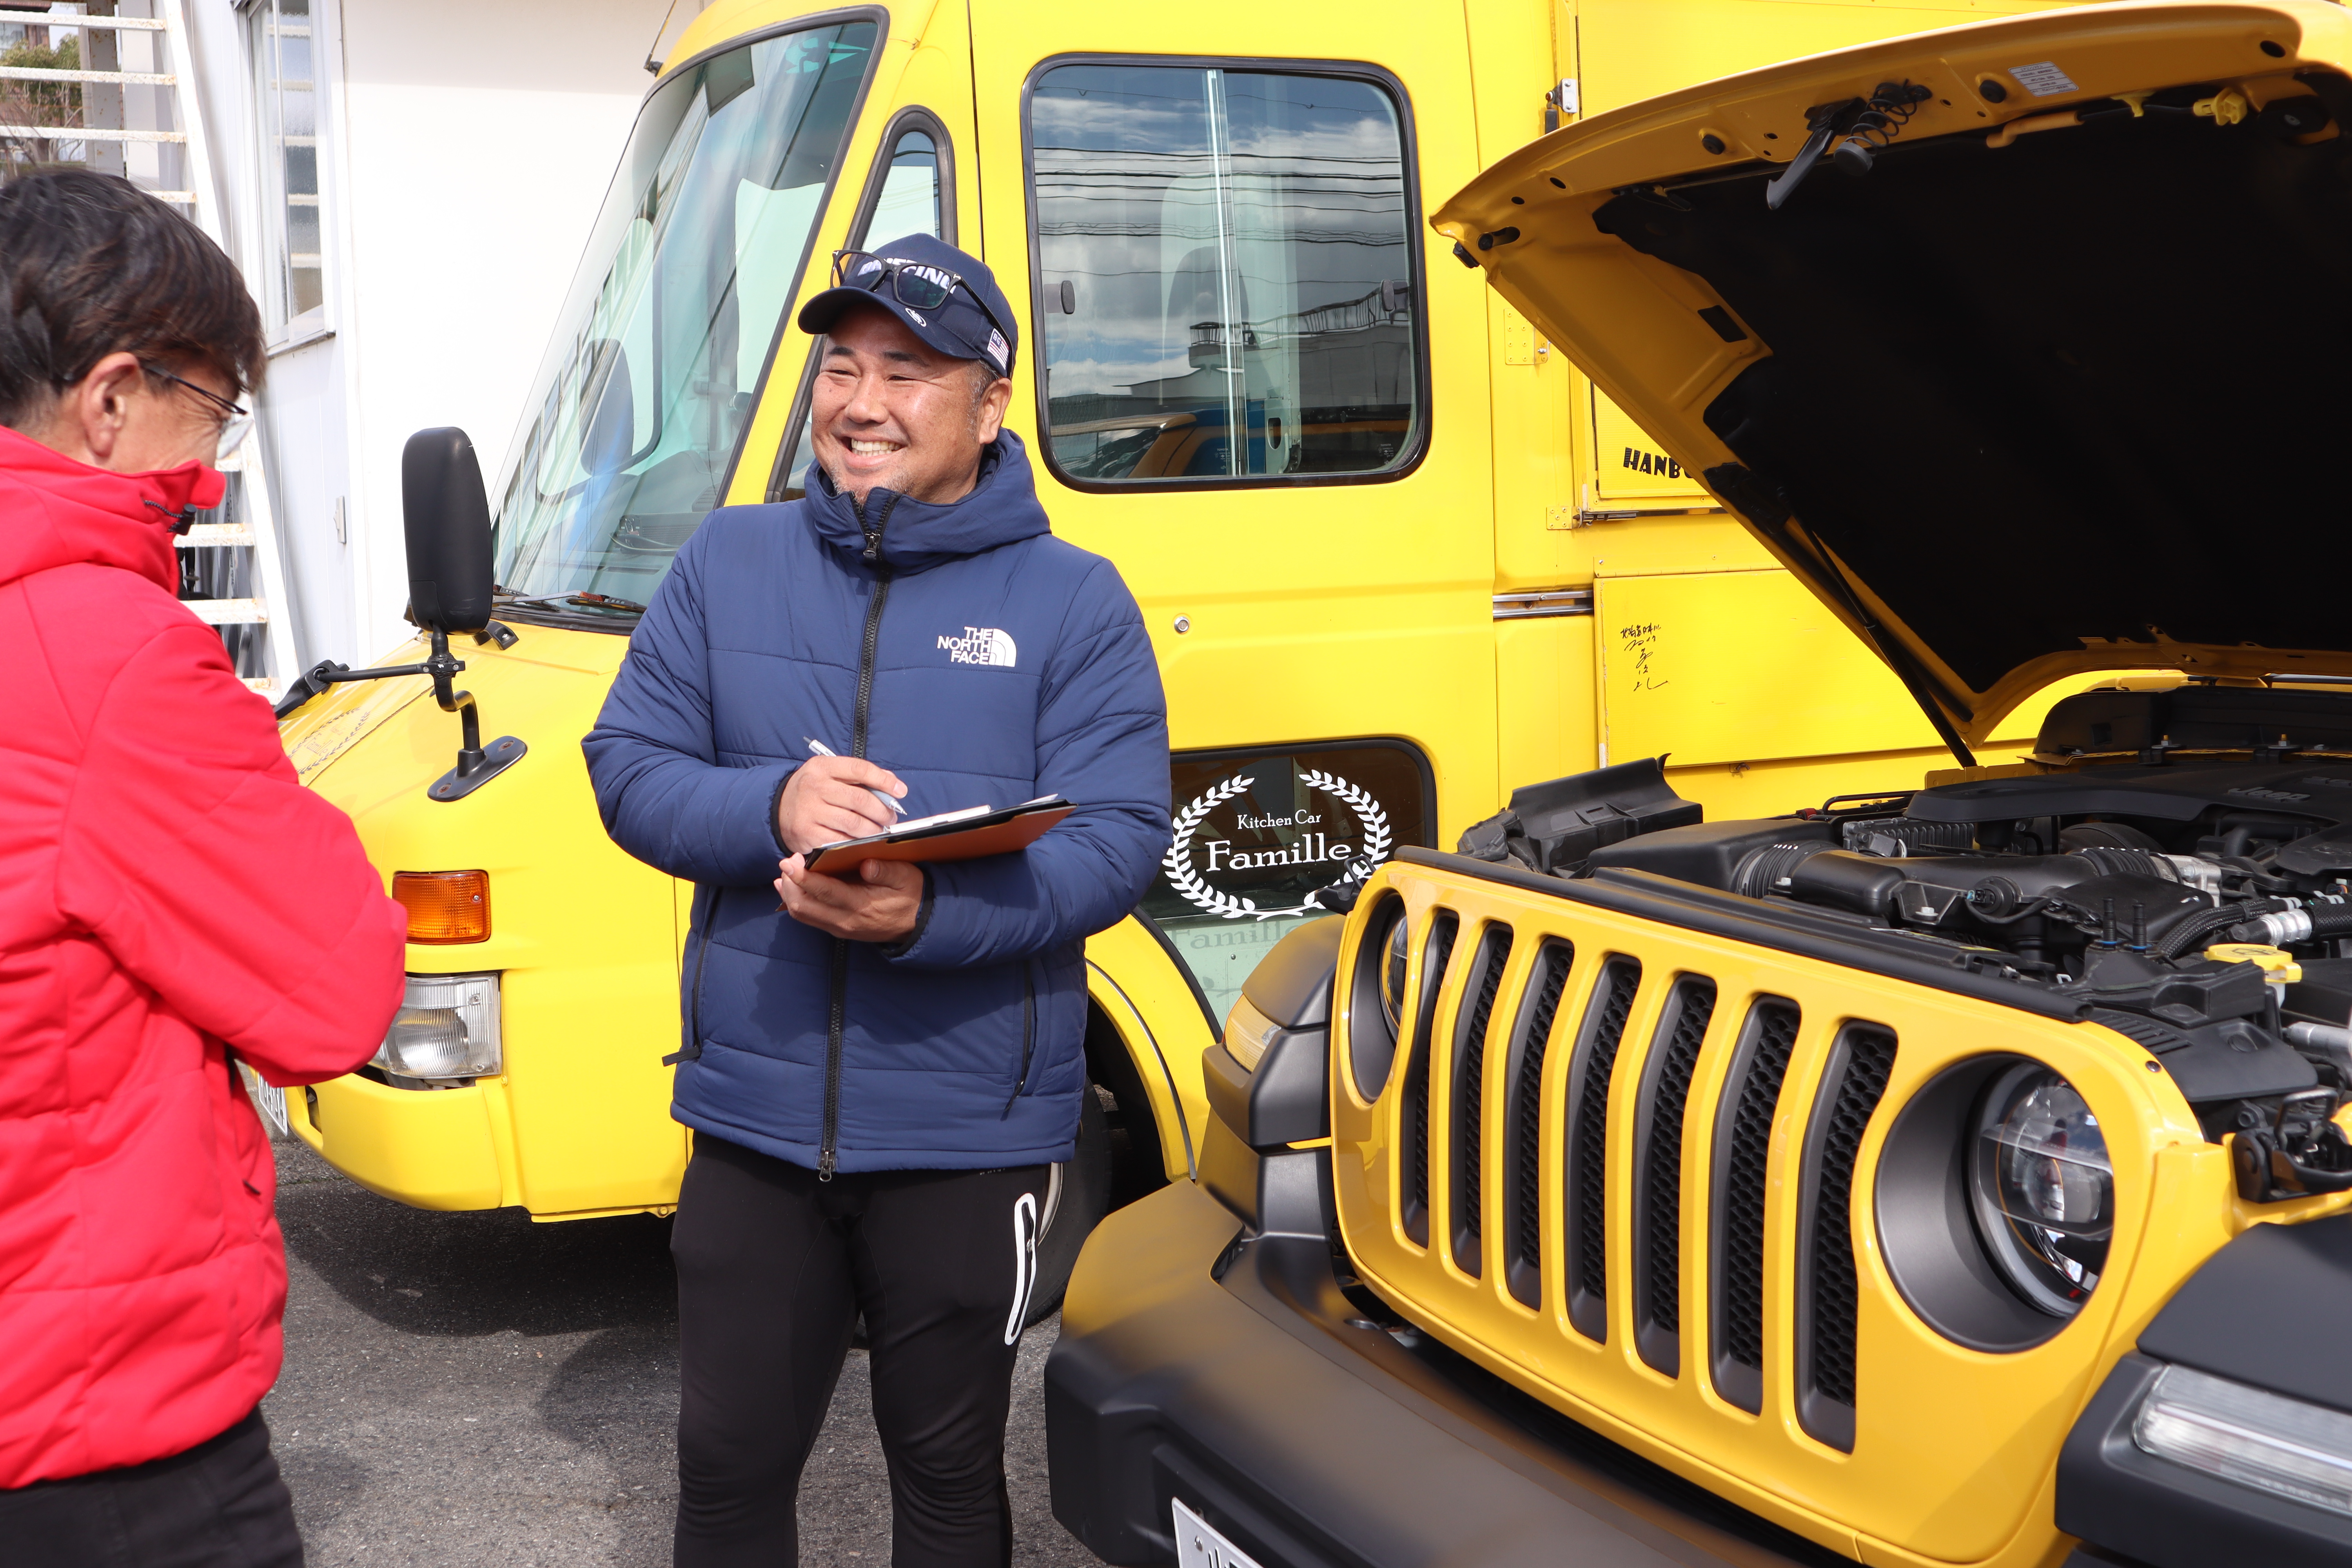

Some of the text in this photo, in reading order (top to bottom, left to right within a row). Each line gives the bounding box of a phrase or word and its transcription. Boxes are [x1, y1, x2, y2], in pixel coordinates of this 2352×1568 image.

[993, 333, 1001, 346] BG
[1623, 446, 1693, 479] HANB
[964, 626, 993, 640] THE
[937, 635, 992, 653] NORTH
[951, 650, 990, 665] FACE
[2228, 787, 2311, 802] Jeep
[1237, 809, 1321, 829] Kitchen Car
[1205, 832, 1352, 872] Famille
